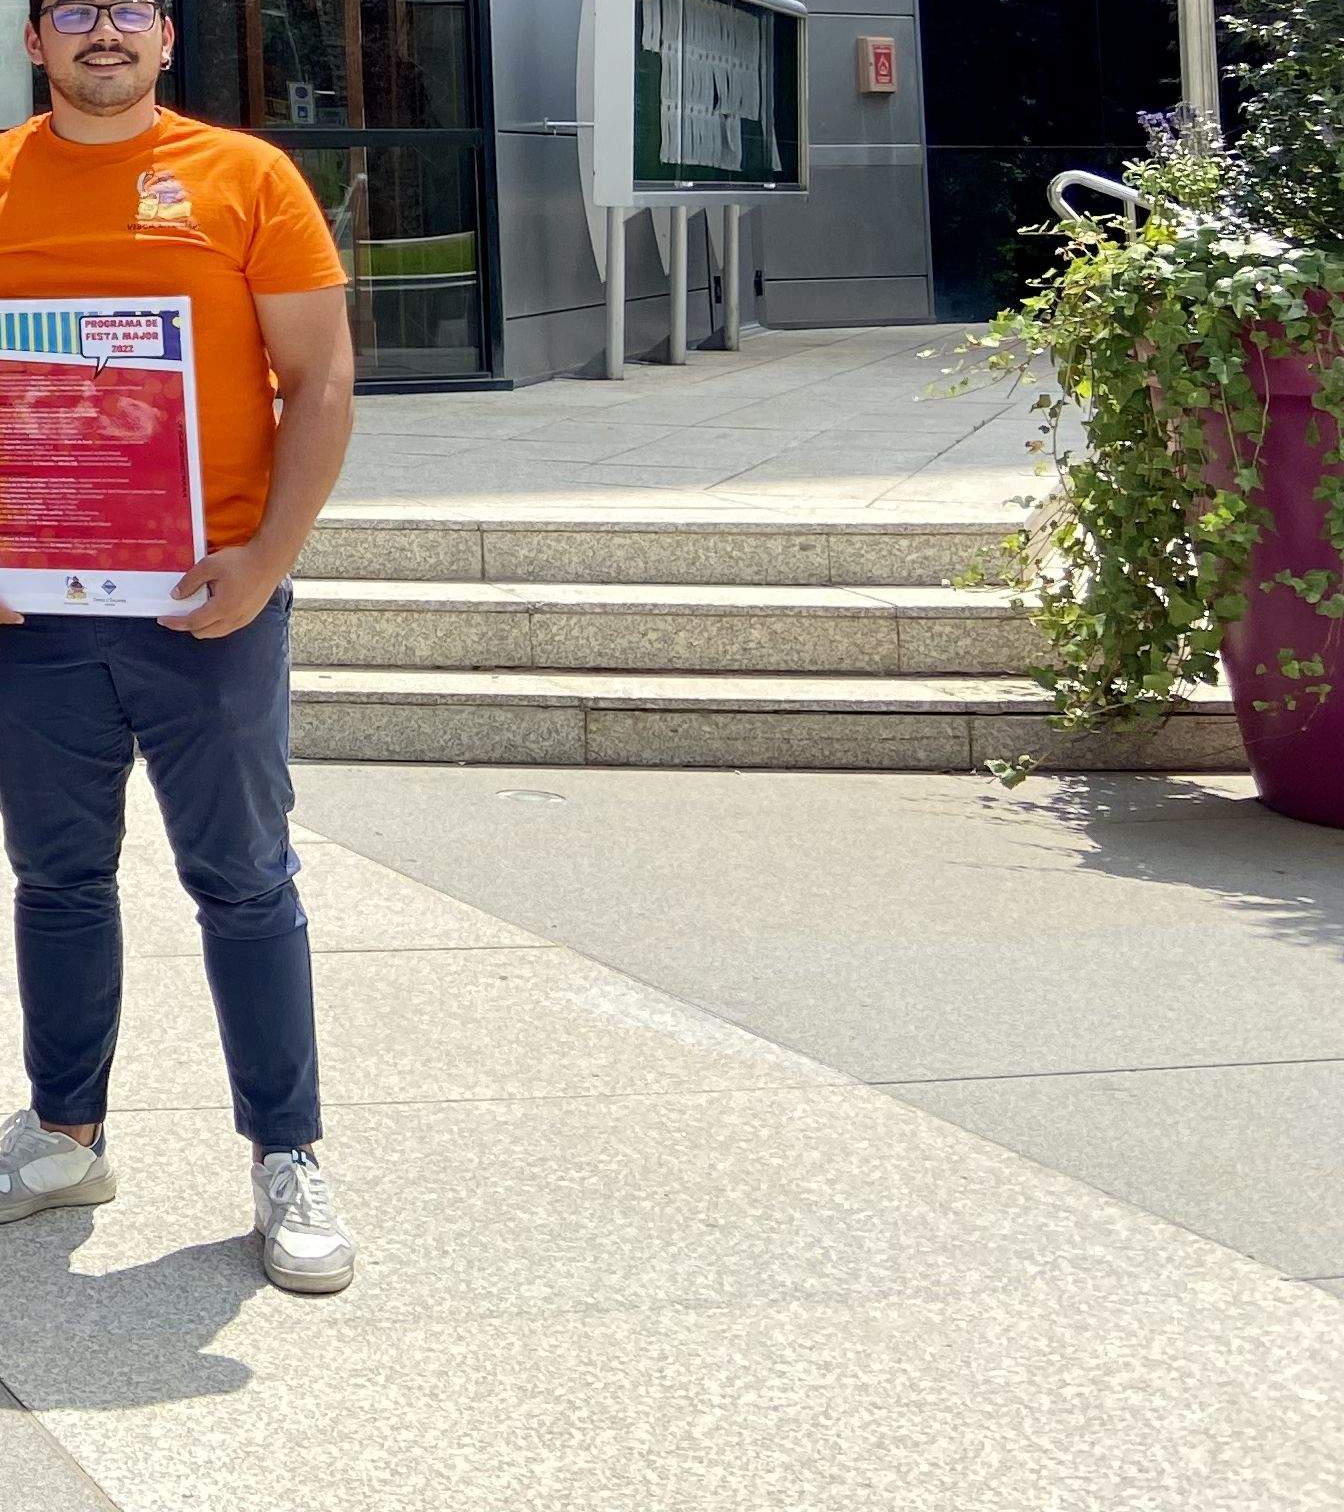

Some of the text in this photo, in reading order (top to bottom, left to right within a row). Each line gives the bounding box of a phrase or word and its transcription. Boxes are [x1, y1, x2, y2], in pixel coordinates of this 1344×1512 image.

[85, 319, 142, 328] PROGRAMA
[85, 332, 159, 341] FESTA MAJOR
